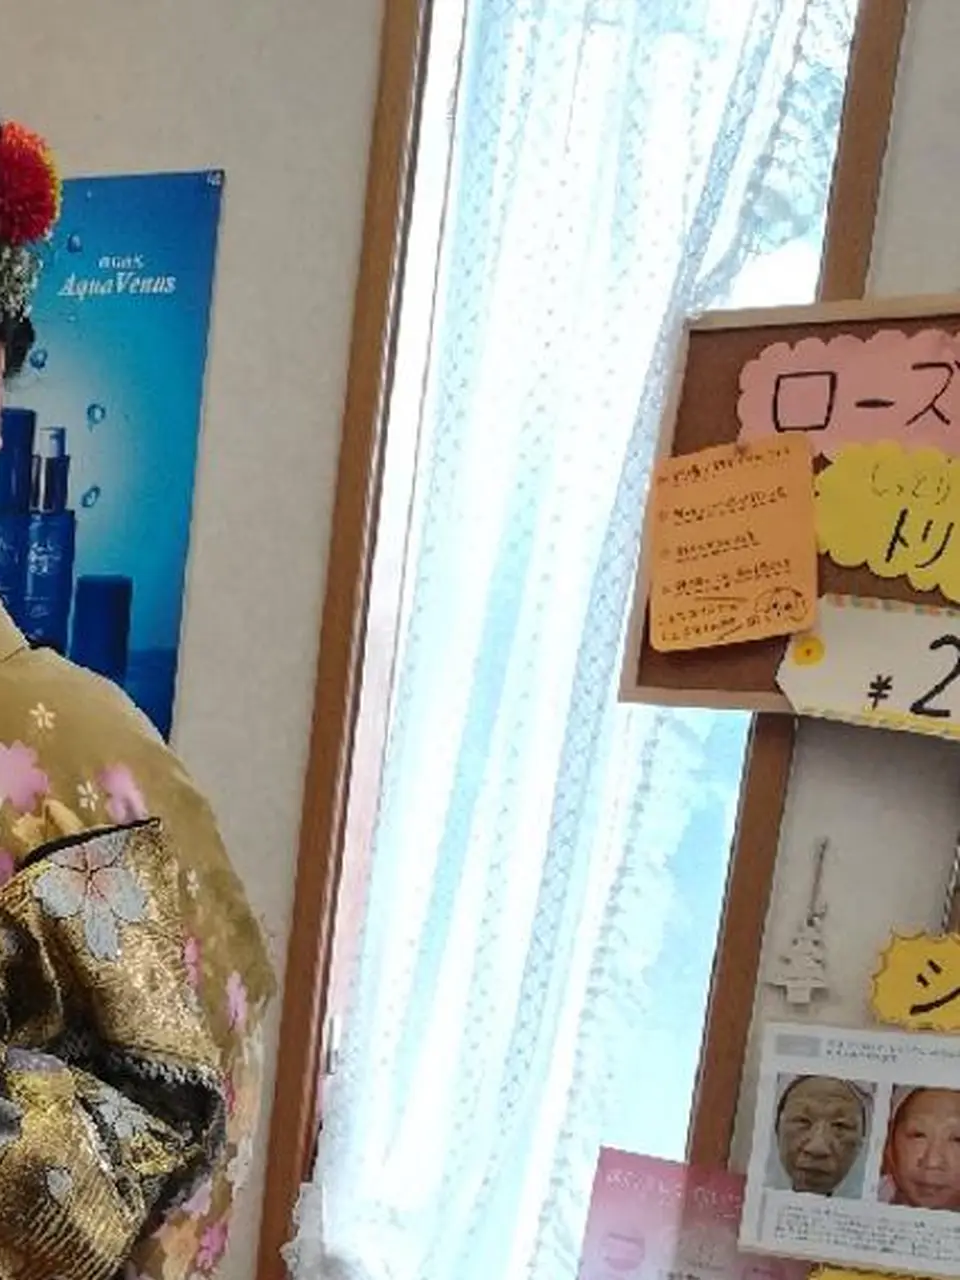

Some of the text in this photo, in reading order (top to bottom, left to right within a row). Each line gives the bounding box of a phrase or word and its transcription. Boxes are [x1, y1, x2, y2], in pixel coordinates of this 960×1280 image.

[772, 360, 960, 432] ローズ
[885, 508, 954, 569] トリ
